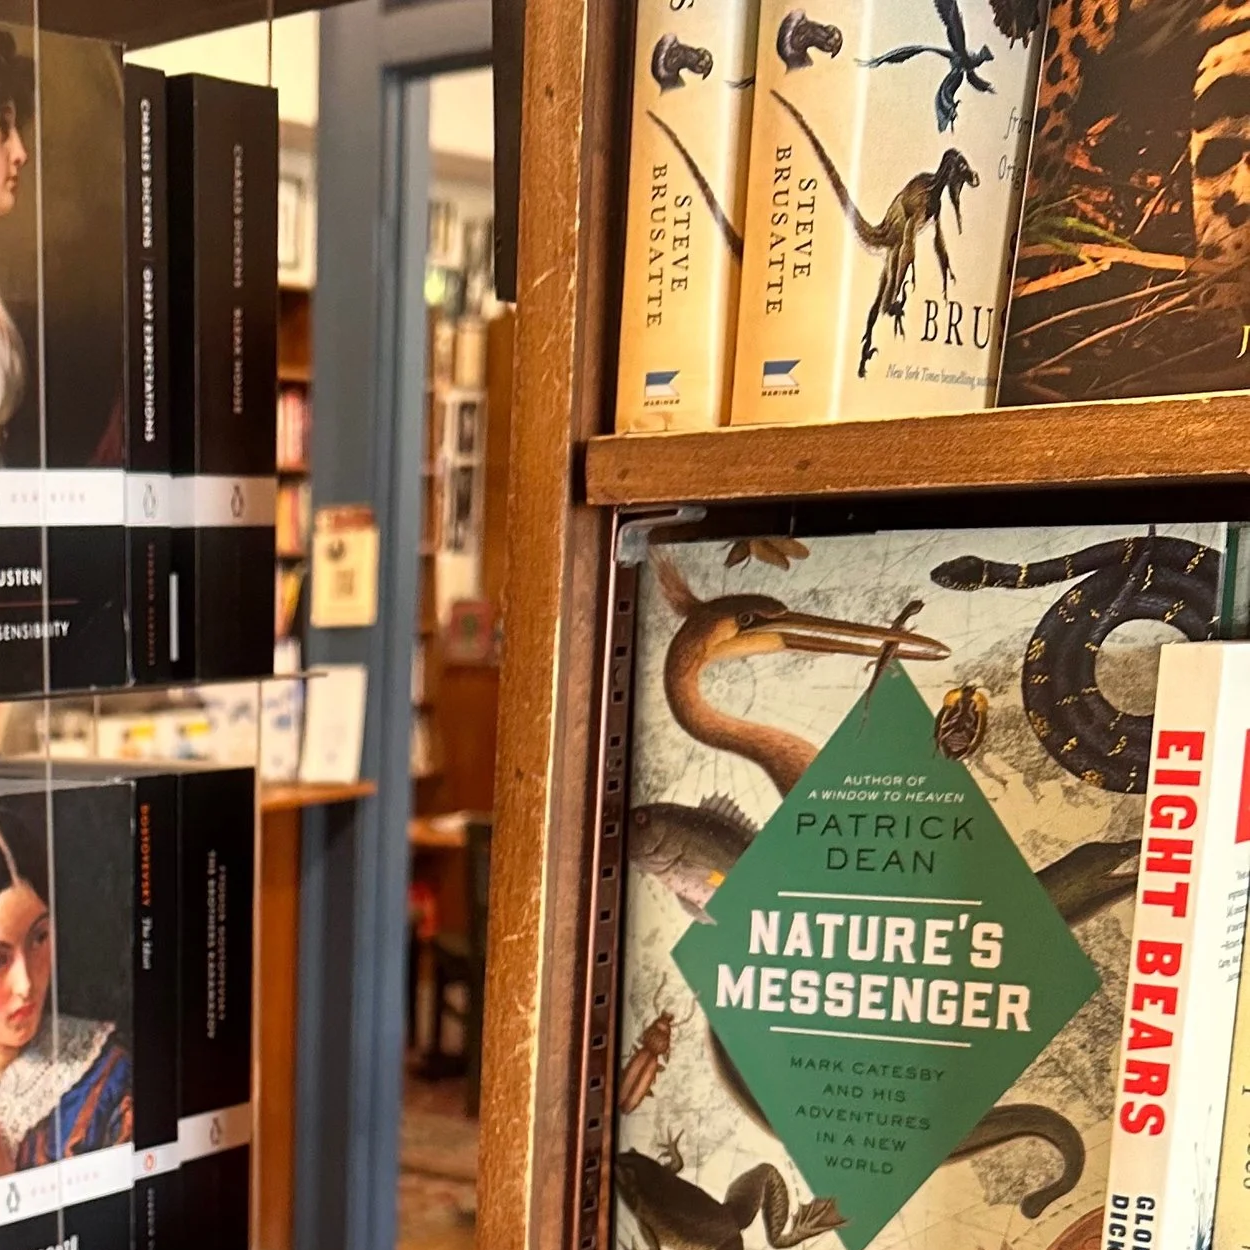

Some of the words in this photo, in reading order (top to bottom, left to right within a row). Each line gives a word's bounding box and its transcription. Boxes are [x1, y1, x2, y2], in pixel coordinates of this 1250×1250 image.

[139, 99, 151, 172] CHARLES
[141, 175, 153, 248] DICKENS
[671, 195, 692, 292] STEVE
[765, 145, 793, 316] BRUSATTE
[793, 178, 817, 280] STEVE
[647, 164, 669, 328] BRUSATTE
[142, 267, 154, 320] GREAT
[144, 323, 156, 442] EXPECTATIONS
[808, 790, 817, 800] A
[820, 790, 879, 803] WINDOW
[881, 791, 899, 803] TO
[902, 791, 965, 804] HEAVEN
[843, 774, 902, 787] AUTHOR
[904, 775, 927, 787] OF
[140, 803, 150, 906] DOSTOYEVSKY
[795, 811, 976, 842] PATRICK
[1141, 730, 1206, 918] EIGHT
[825, 847, 936, 875] DEAN
[749, 908, 1005, 969] NATURE'S
[714, 963, 1033, 1033] MESSENGER
[790, 1055, 845, 1074] MARK
[851, 1062, 945, 1083] CATESBY
[1119, 939, 1183, 1137] BEARS
[795, 1104, 932, 1132] ADVENTURES
[822, 1083, 864, 1100] AND
[872, 1087, 907, 1103] HIS
[816, 1130, 837, 1144] IN
[842, 1133, 856, 1147] A
[862, 1136, 908, 1152] NEW
[824, 1155, 895, 1176] WORLD
